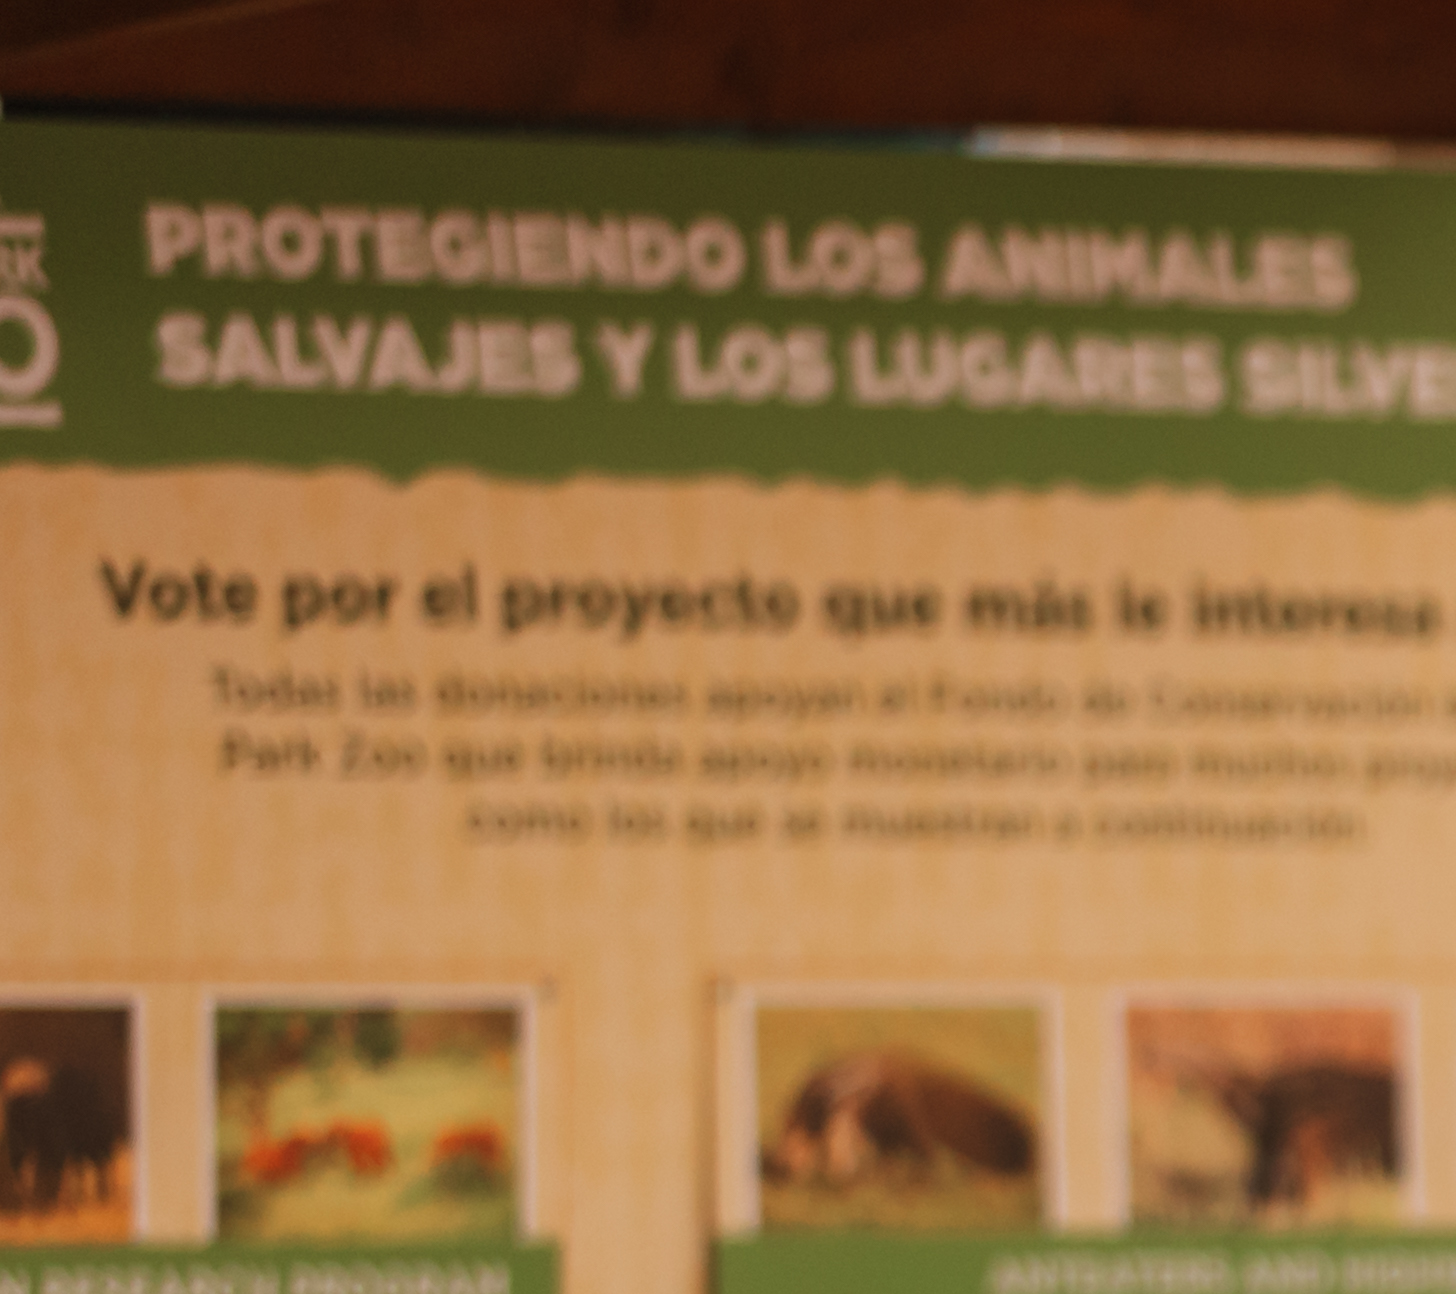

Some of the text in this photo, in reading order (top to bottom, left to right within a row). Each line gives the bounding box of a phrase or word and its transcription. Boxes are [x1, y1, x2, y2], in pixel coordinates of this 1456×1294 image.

[147, 204, 746, 290] PROTEGIENDO
[763, 220, 924, 298] LOS
[942, 222, 1357, 310] ANIMALES
[157, 311, 580, 394] SALVAJES
[602, 320, 655, 398] Y
[674, 322, 835, 403] LOS
[850, 325, 1225, 413] LUGARES
[99, 559, 259, 626] Vote
[281, 571, 397, 640] por
[422, 563, 479, 624] el
[499, 569, 798, 643] proyecto
[822, 581, 940, 646] que
[1114, 574, 1166, 636] le
